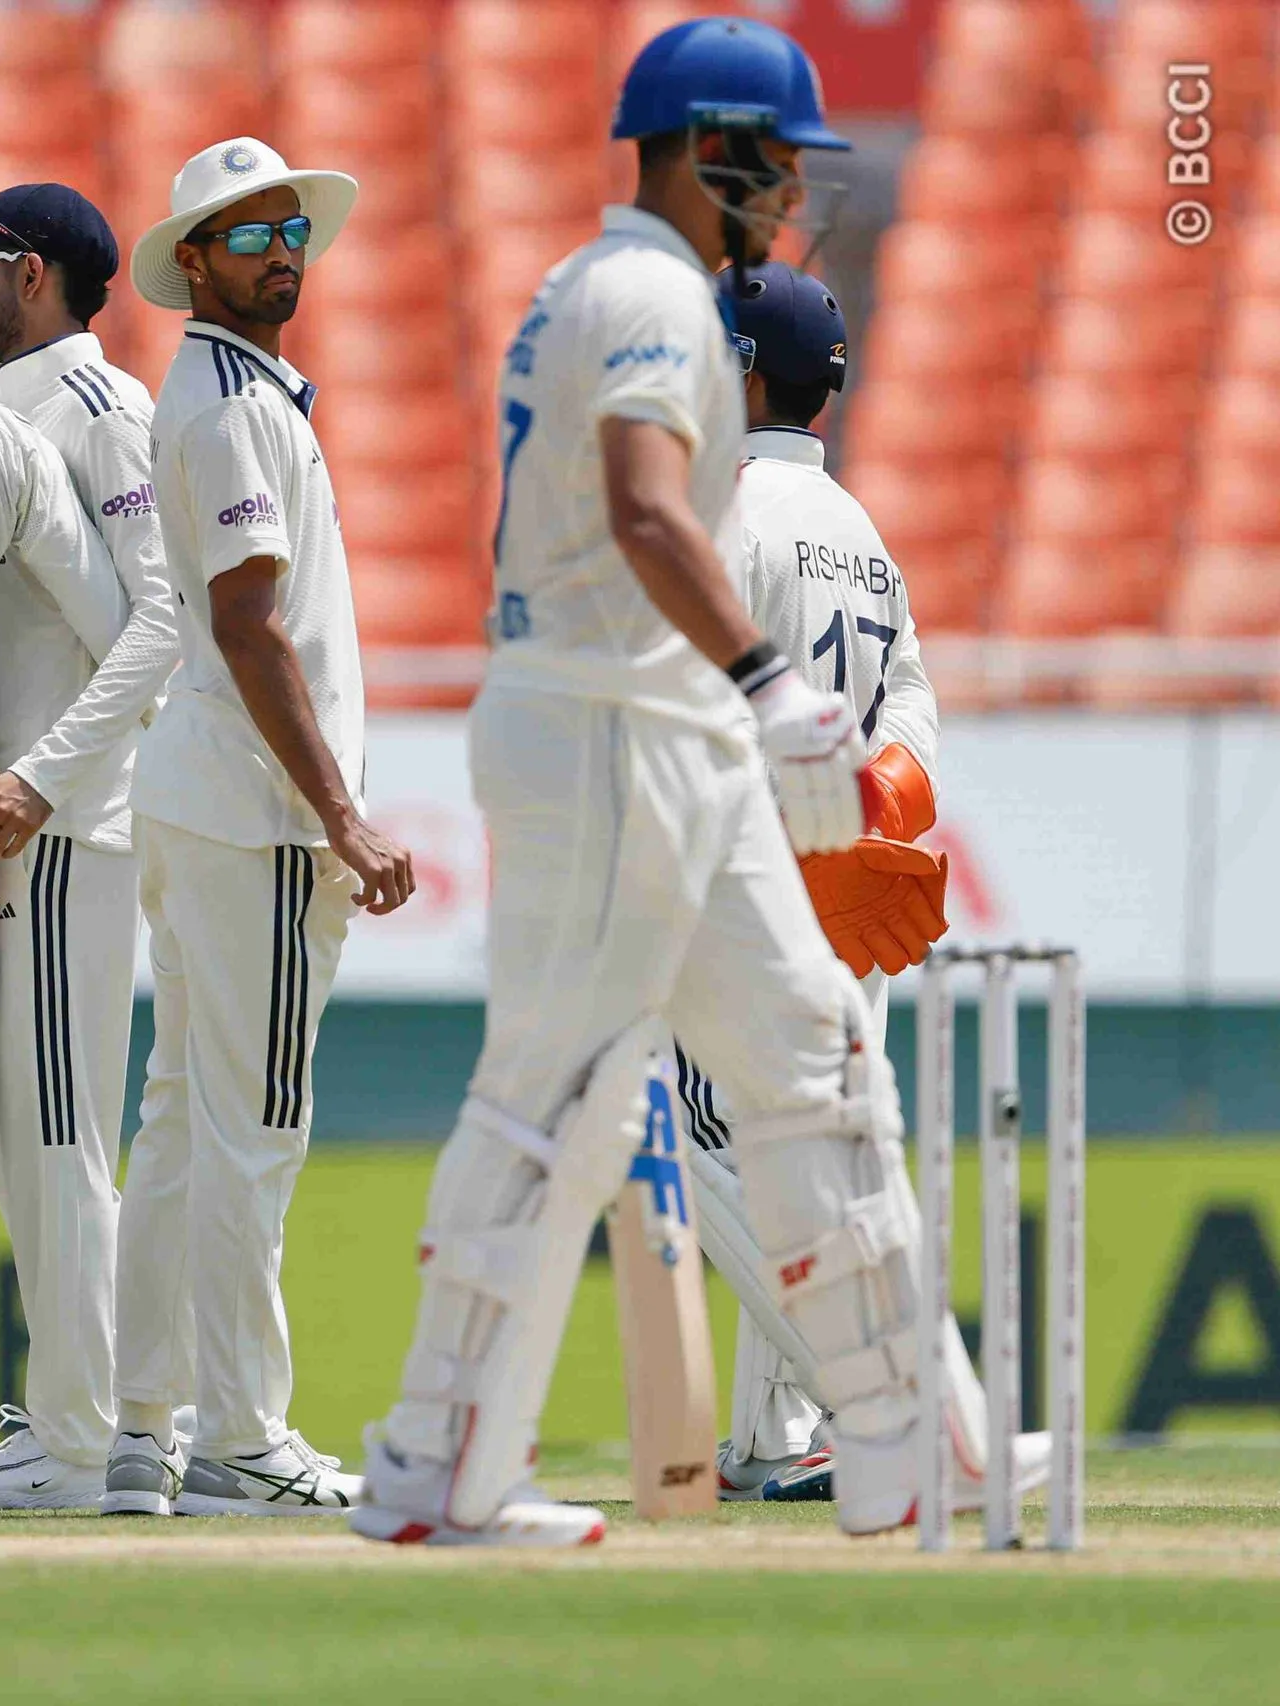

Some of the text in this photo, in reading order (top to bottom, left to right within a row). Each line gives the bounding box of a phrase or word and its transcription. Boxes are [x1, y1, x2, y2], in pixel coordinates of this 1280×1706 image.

[813, 610, 898, 742] 17
[779, 1255, 818, 1288] SF
[660, 1462, 707, 1488] SF
